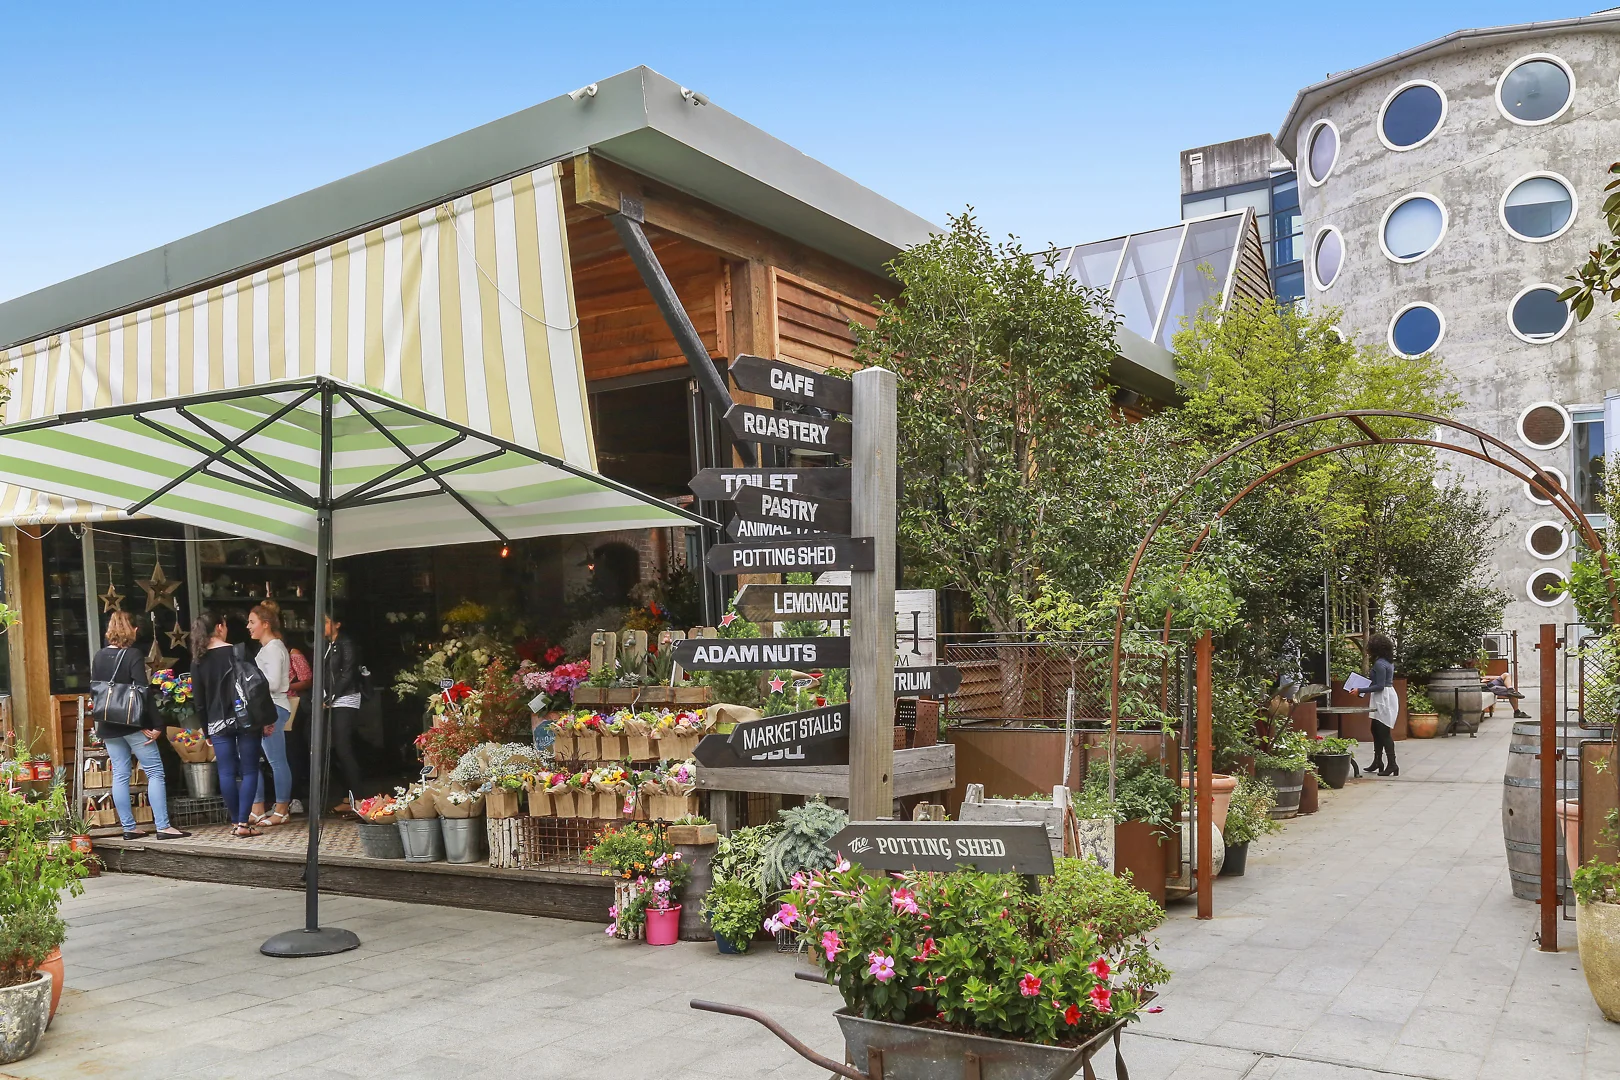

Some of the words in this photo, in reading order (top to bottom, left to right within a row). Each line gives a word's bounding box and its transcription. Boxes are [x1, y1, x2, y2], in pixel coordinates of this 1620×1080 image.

[769, 368, 815, 398] CAFE
[743, 412, 829, 445] ROASTERY
[761, 494, 819, 523] PASTRY
[737, 520, 792, 538] ANIMAL
[733, 548, 796, 567] POTTING
[798, 546, 836, 565] SHED
[774, 592, 849, 614] LEMONADE
[693, 644, 759, 663] ADAM
[762, 643, 817, 662] NUTS
[893, 671, 931, 691] TRIUM
[743, 720, 798, 751] MARKET
[799, 712, 842, 739] STALLS
[875, 837, 951, 860] POTTING
[955, 838, 1006, 857] SHED
